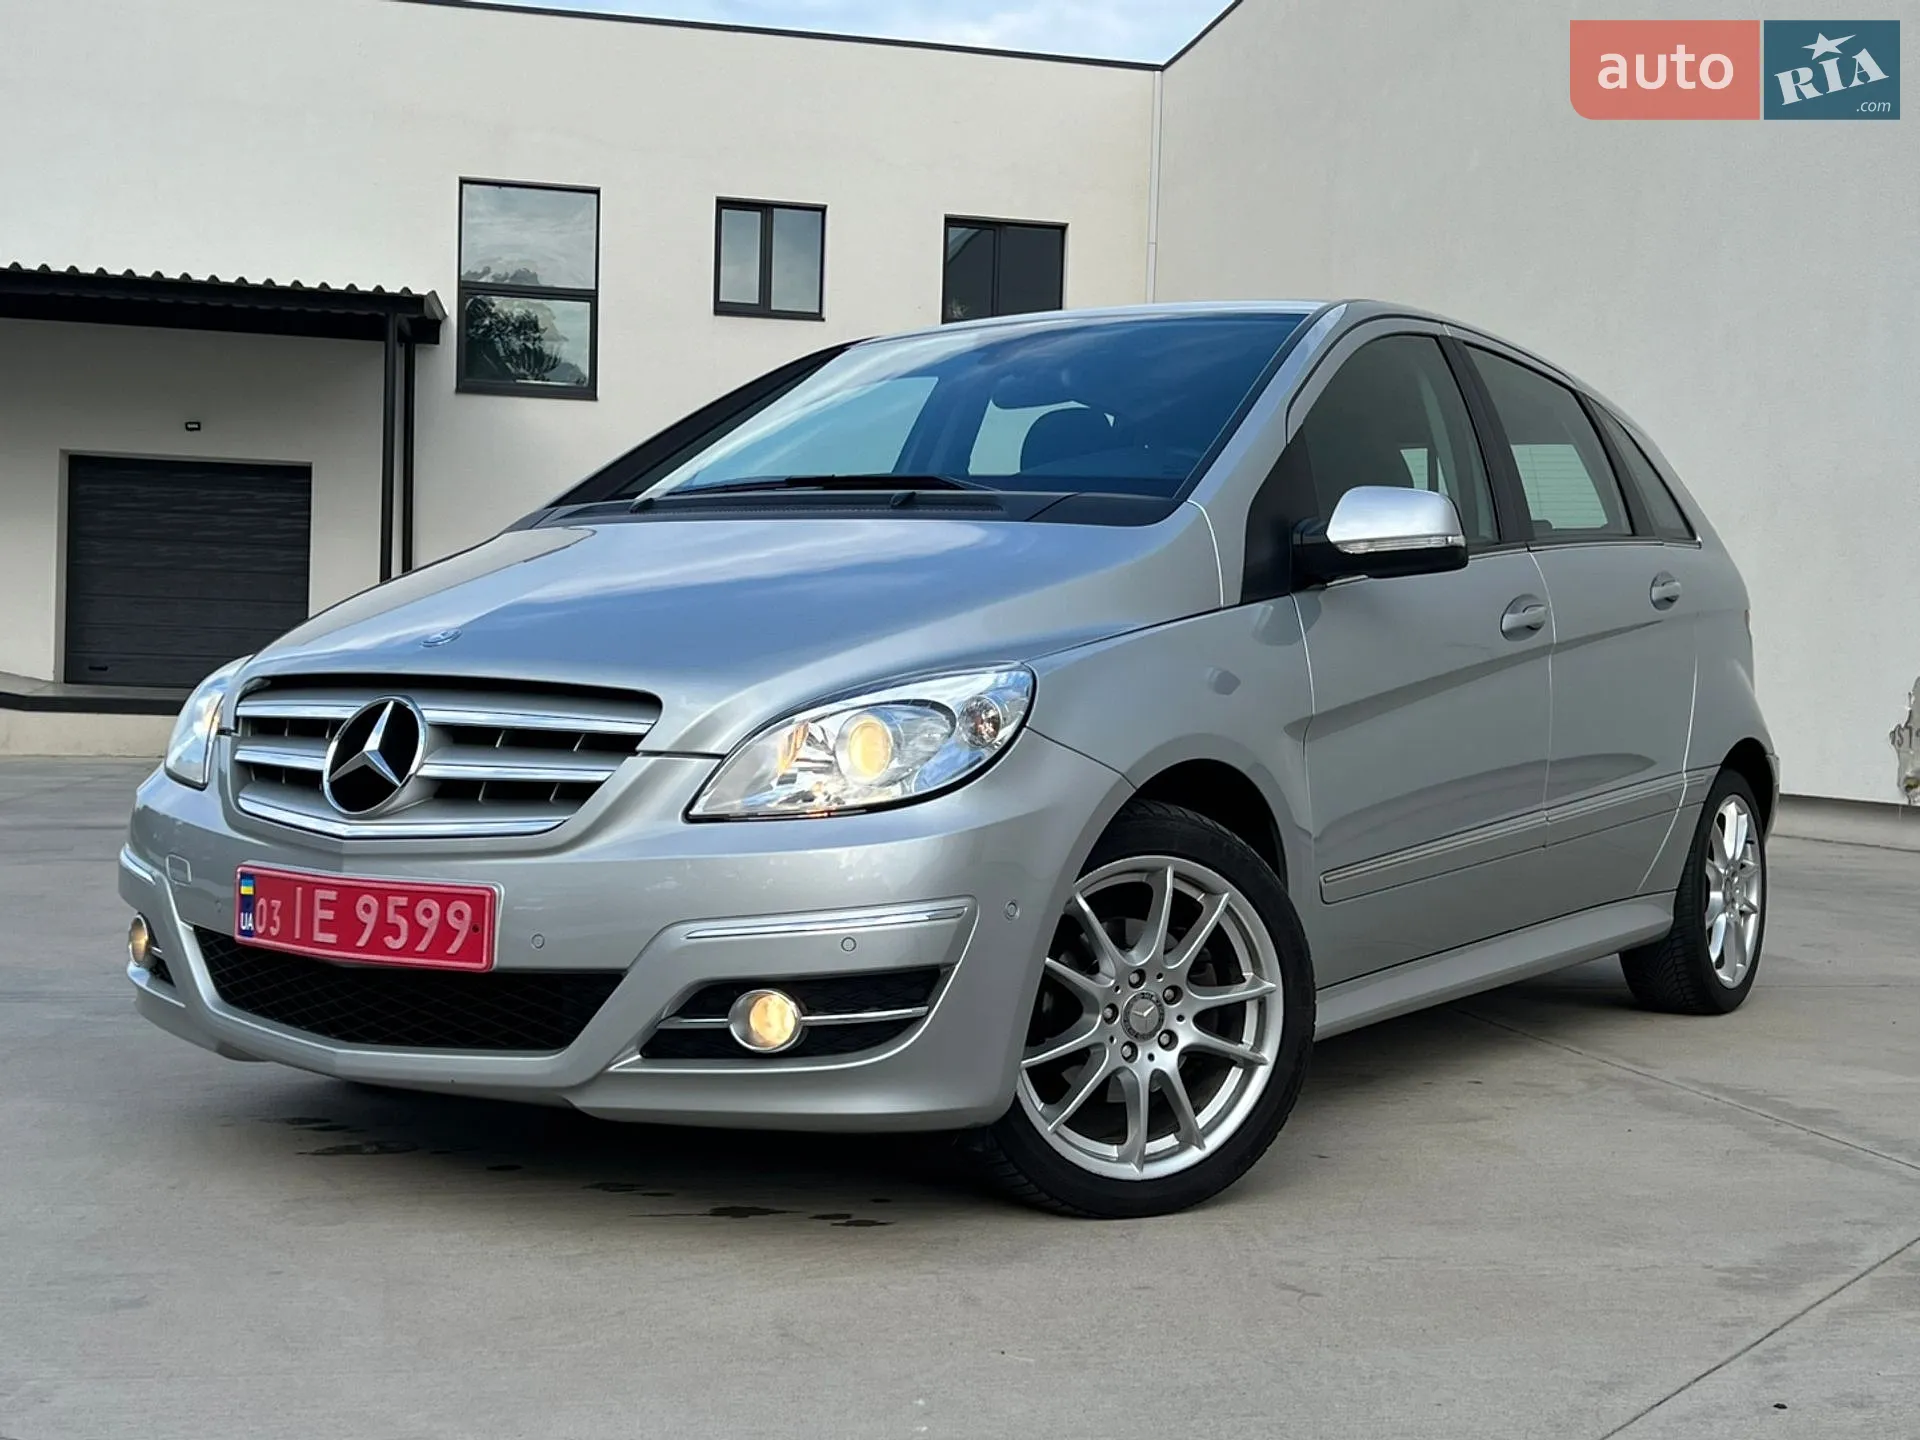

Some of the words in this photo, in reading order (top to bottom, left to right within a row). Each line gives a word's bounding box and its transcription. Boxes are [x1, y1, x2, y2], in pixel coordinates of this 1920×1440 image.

[240, 912, 255, 930] UA
[256, 898, 281, 936] 03
[355, 894, 472, 954] 9599
